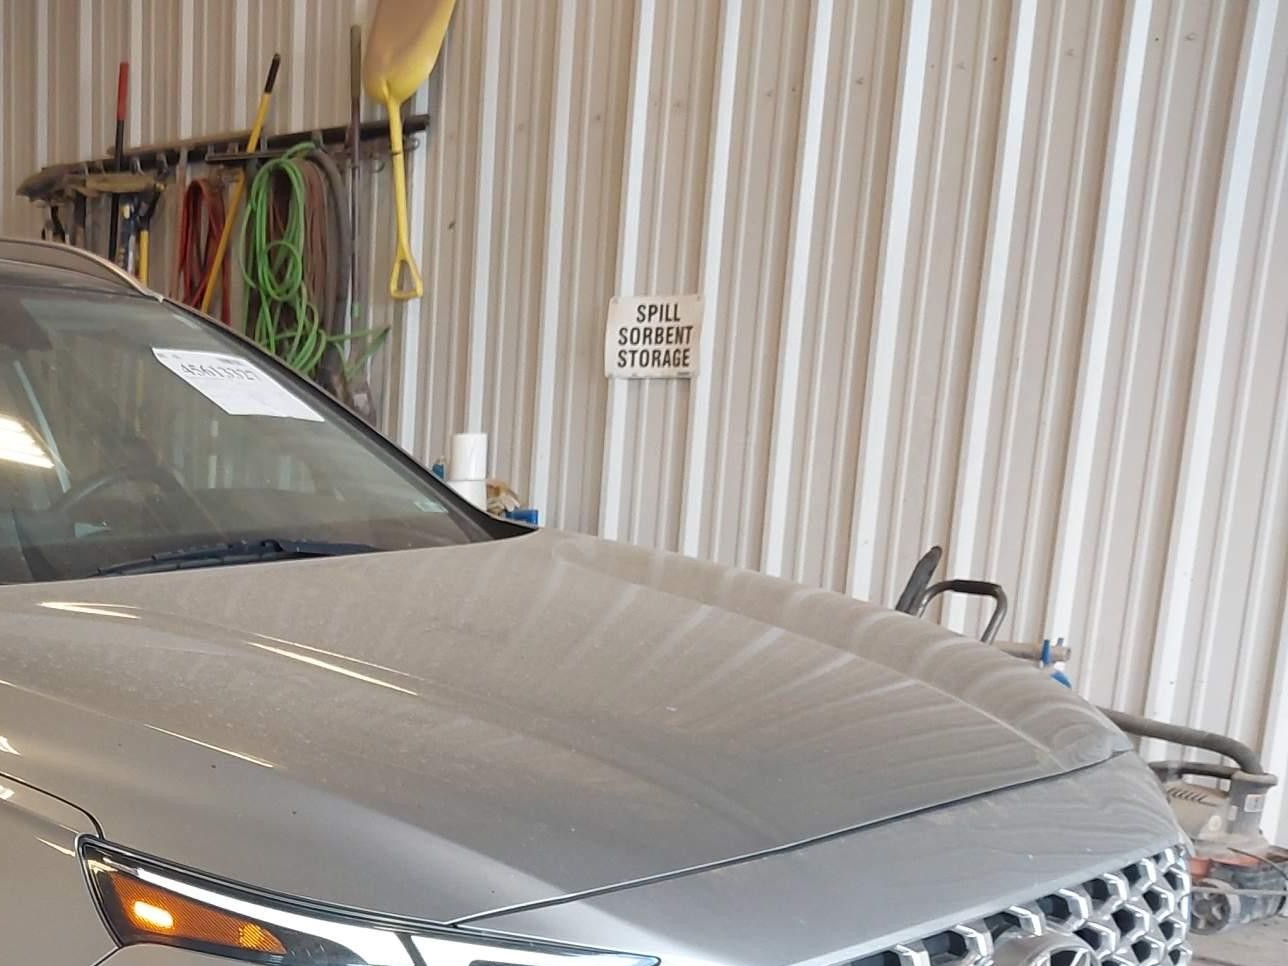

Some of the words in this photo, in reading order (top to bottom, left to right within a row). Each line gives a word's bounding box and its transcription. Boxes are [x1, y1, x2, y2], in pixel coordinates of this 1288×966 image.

[636, 303, 681, 323] SPILL
[618, 325, 694, 345] SORBENT
[617, 348, 690, 368] STORAGE
